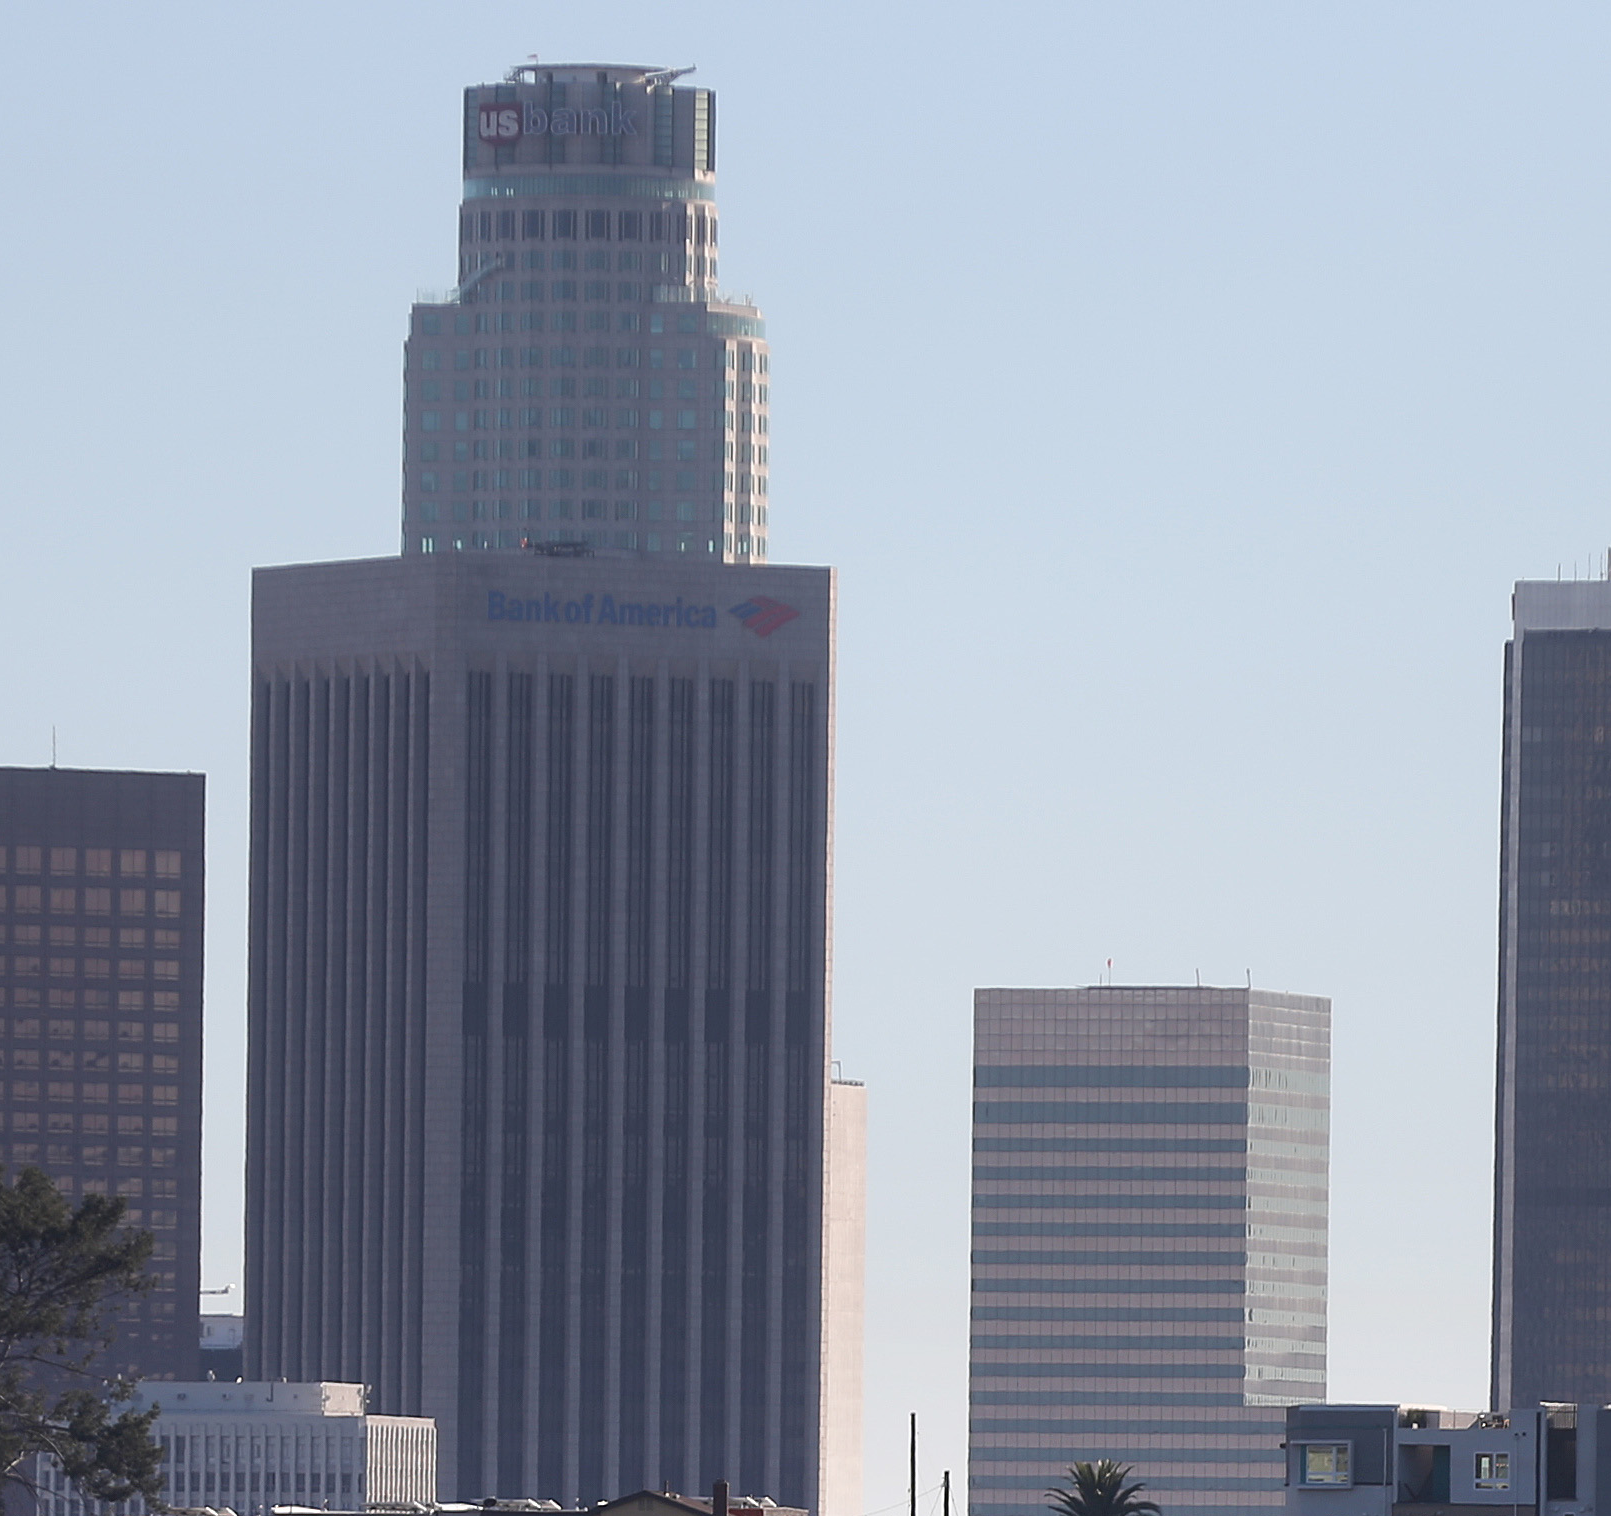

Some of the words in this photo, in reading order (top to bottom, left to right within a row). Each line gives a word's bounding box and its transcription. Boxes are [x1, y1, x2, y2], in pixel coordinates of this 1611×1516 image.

[479, 109, 518, 138] us
[522, 101, 638, 137] bank
[487, 590, 561, 623] Bank
[563, 593, 595, 624] of
[597, 595, 718, 629] America
